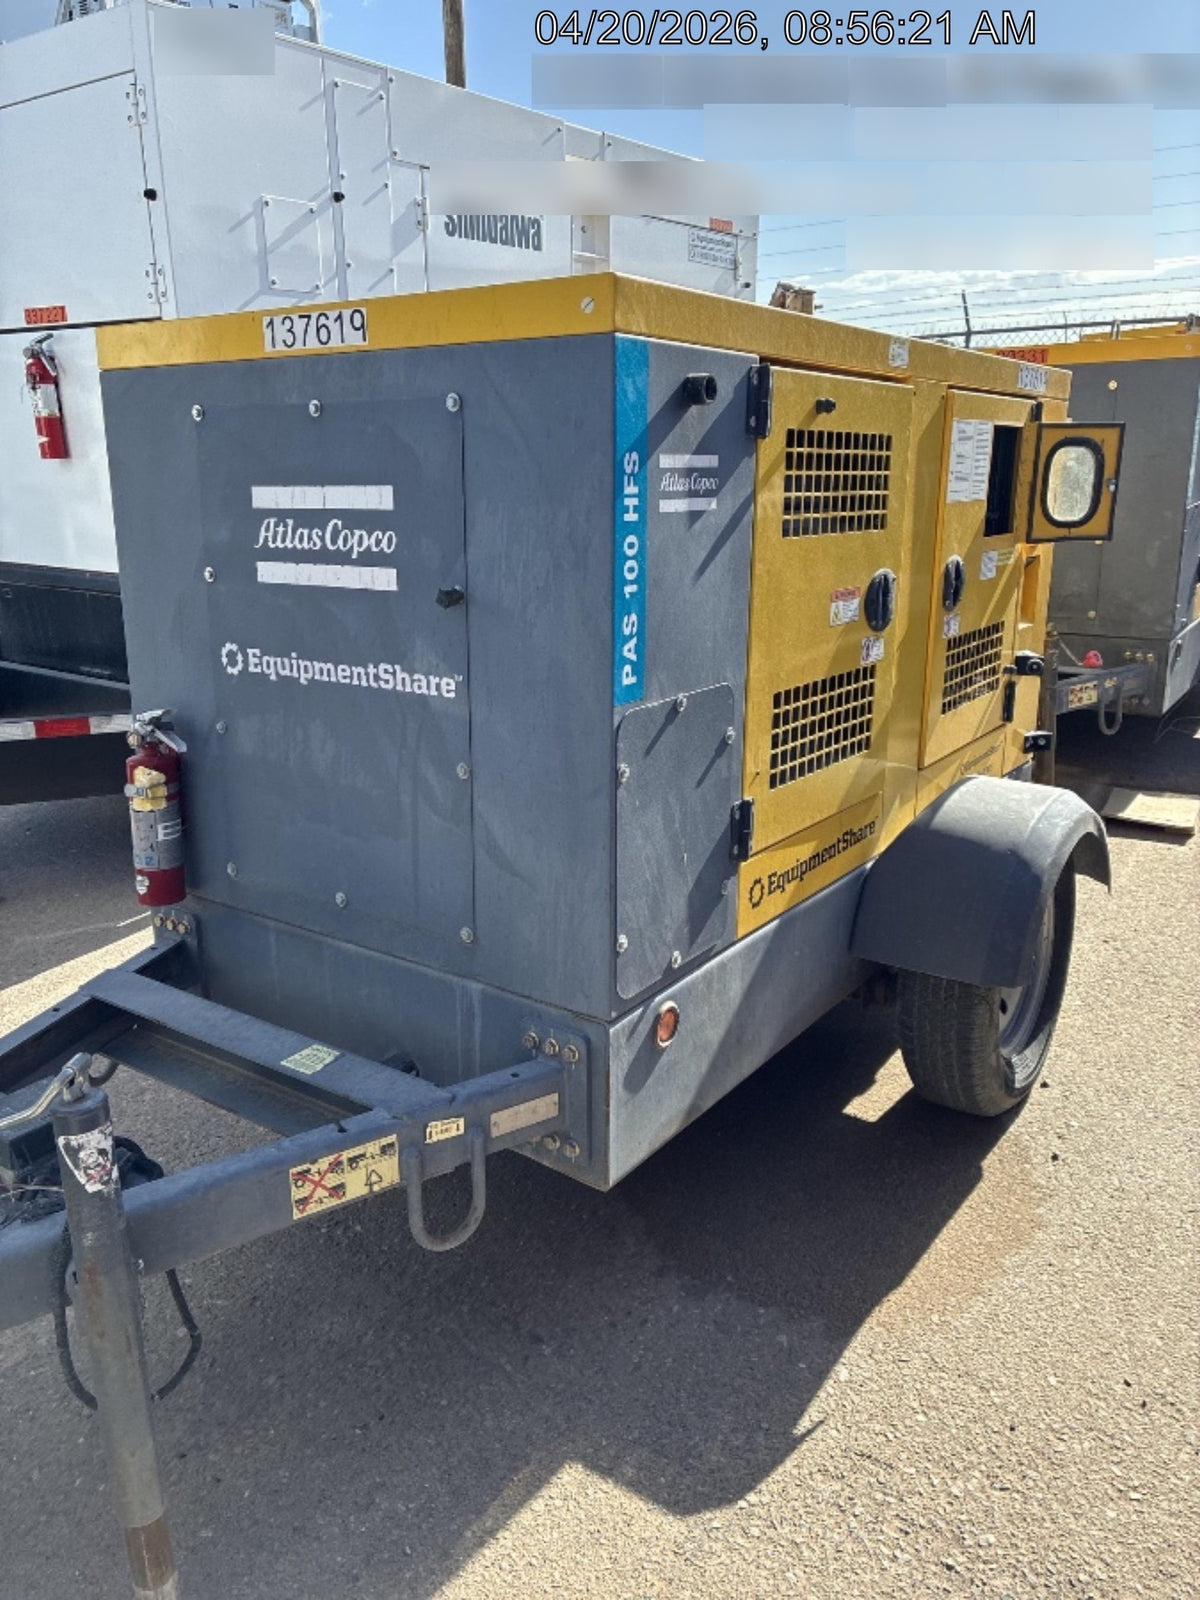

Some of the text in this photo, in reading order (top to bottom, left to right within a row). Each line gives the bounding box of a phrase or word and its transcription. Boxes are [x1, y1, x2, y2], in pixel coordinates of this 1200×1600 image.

[266, 309, 366, 349] 137619
[622, 451, 639, 686] PAS 100 HFS
[247, 648, 456, 698] EquipmentShare
[767, 820, 876, 896] EquipmentShare
